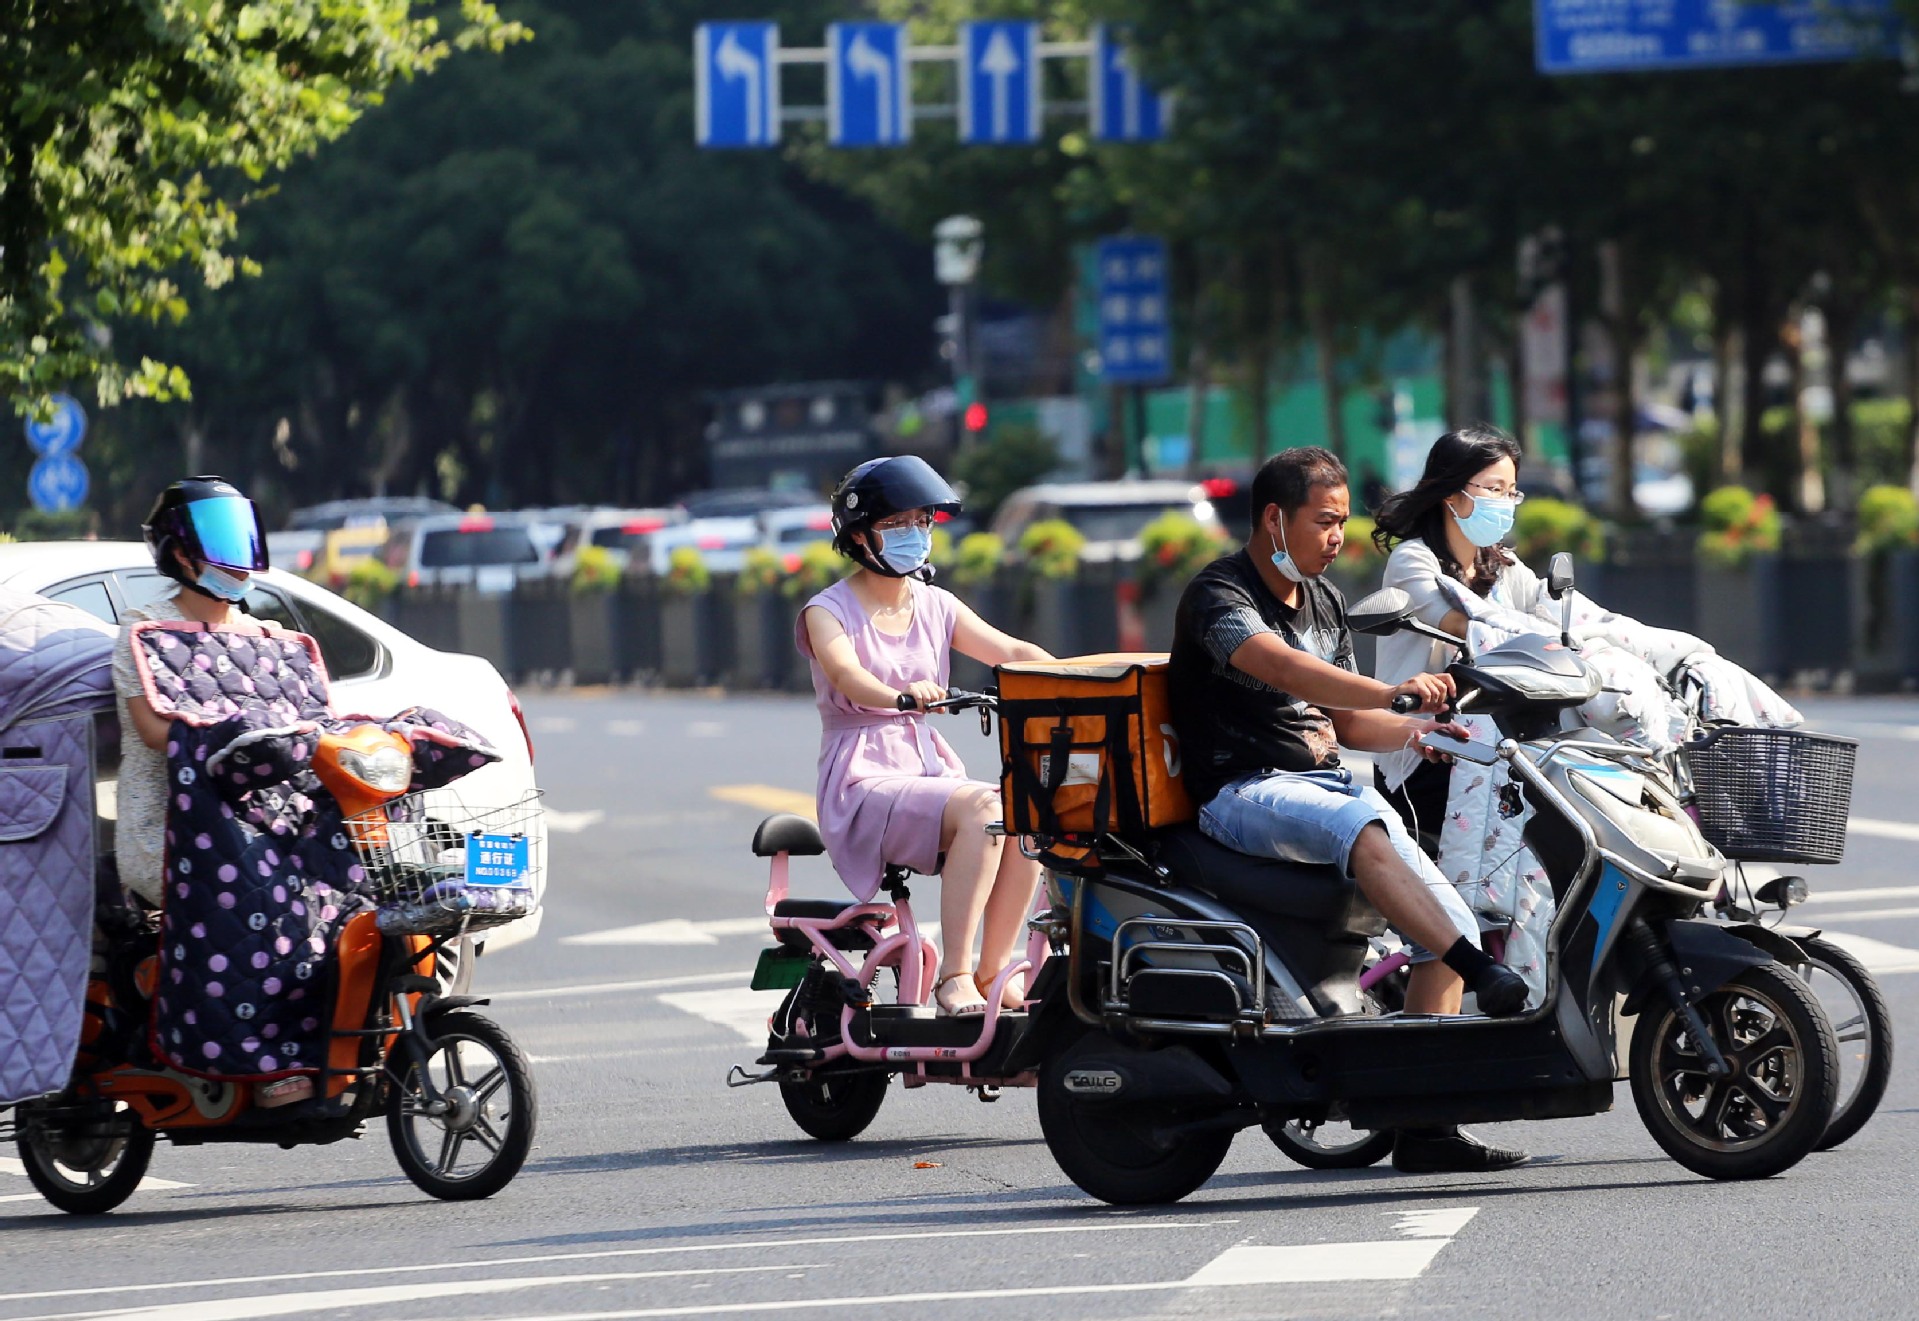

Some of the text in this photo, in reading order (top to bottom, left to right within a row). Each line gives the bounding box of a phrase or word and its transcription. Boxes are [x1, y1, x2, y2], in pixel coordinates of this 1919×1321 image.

[480, 851, 515, 865] 通行证
[1069, 1076, 1117, 1087] TAILG
